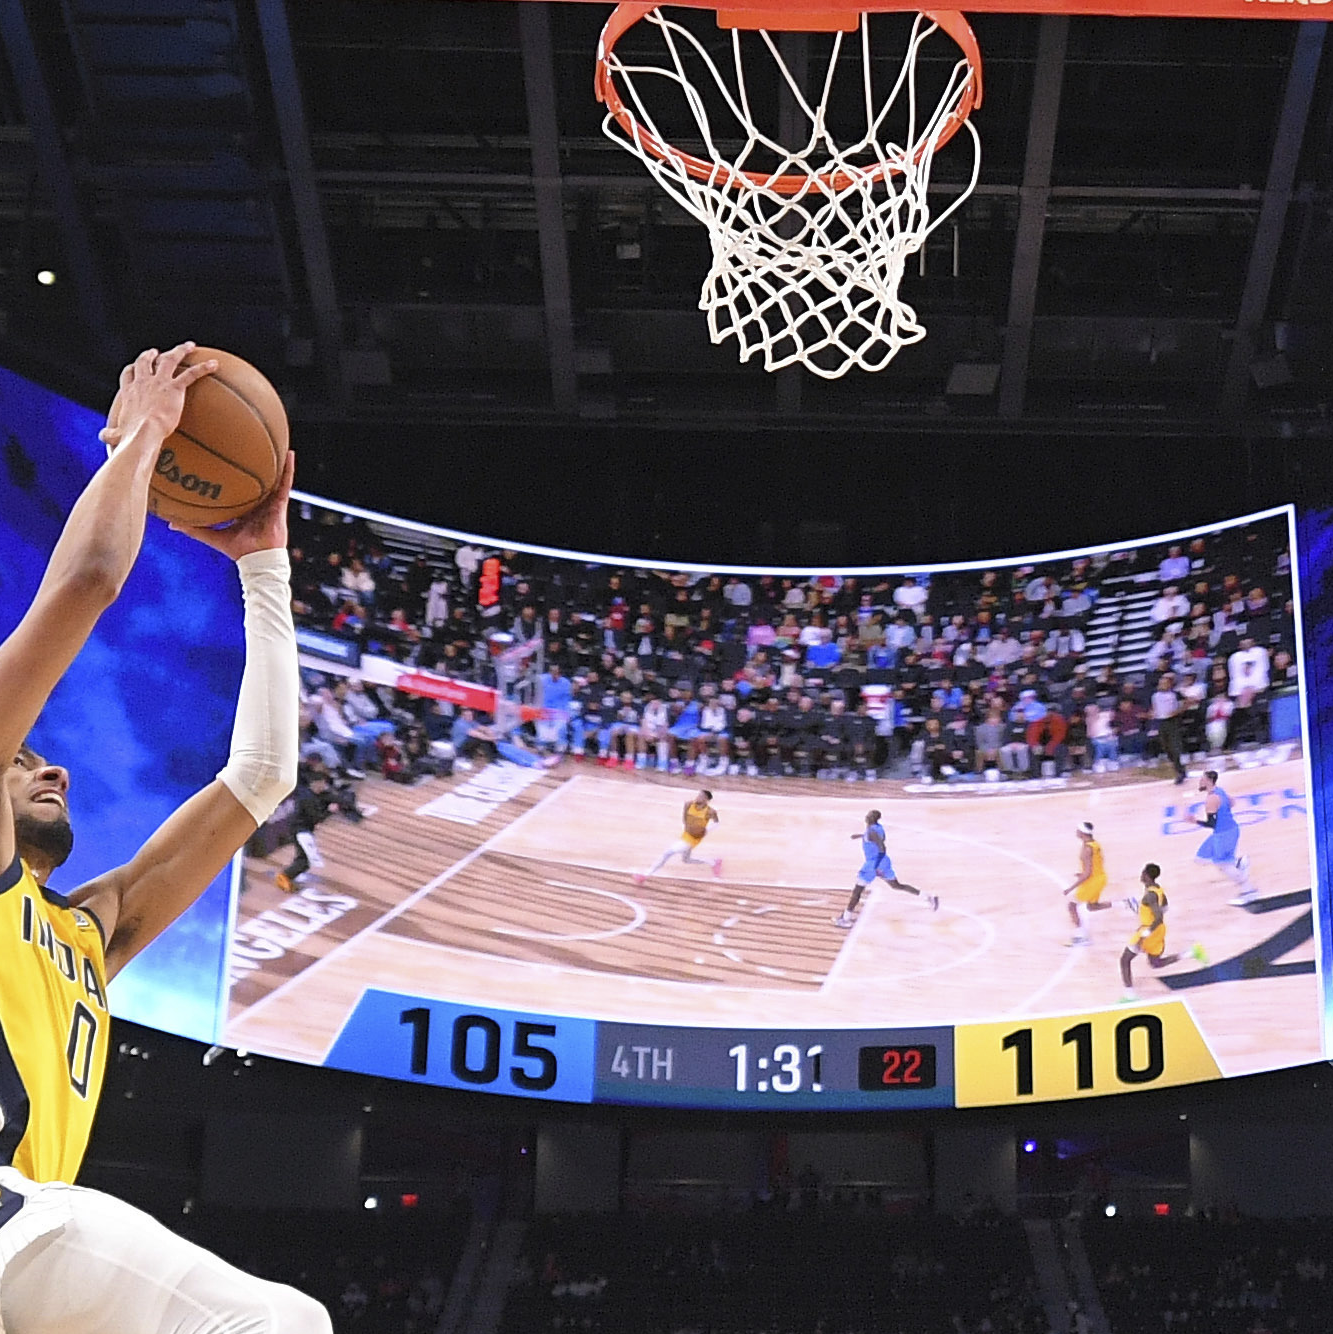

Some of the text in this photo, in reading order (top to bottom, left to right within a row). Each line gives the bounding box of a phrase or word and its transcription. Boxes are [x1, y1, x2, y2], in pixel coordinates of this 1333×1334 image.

[66, 1000, 98, 1100] 0
[399, 1007, 558, 1092] 105
[610, 1045, 673, 1080] 4TH
[882, 1049, 922, 1084] 22
[1002, 1014, 1164, 1096] 110
